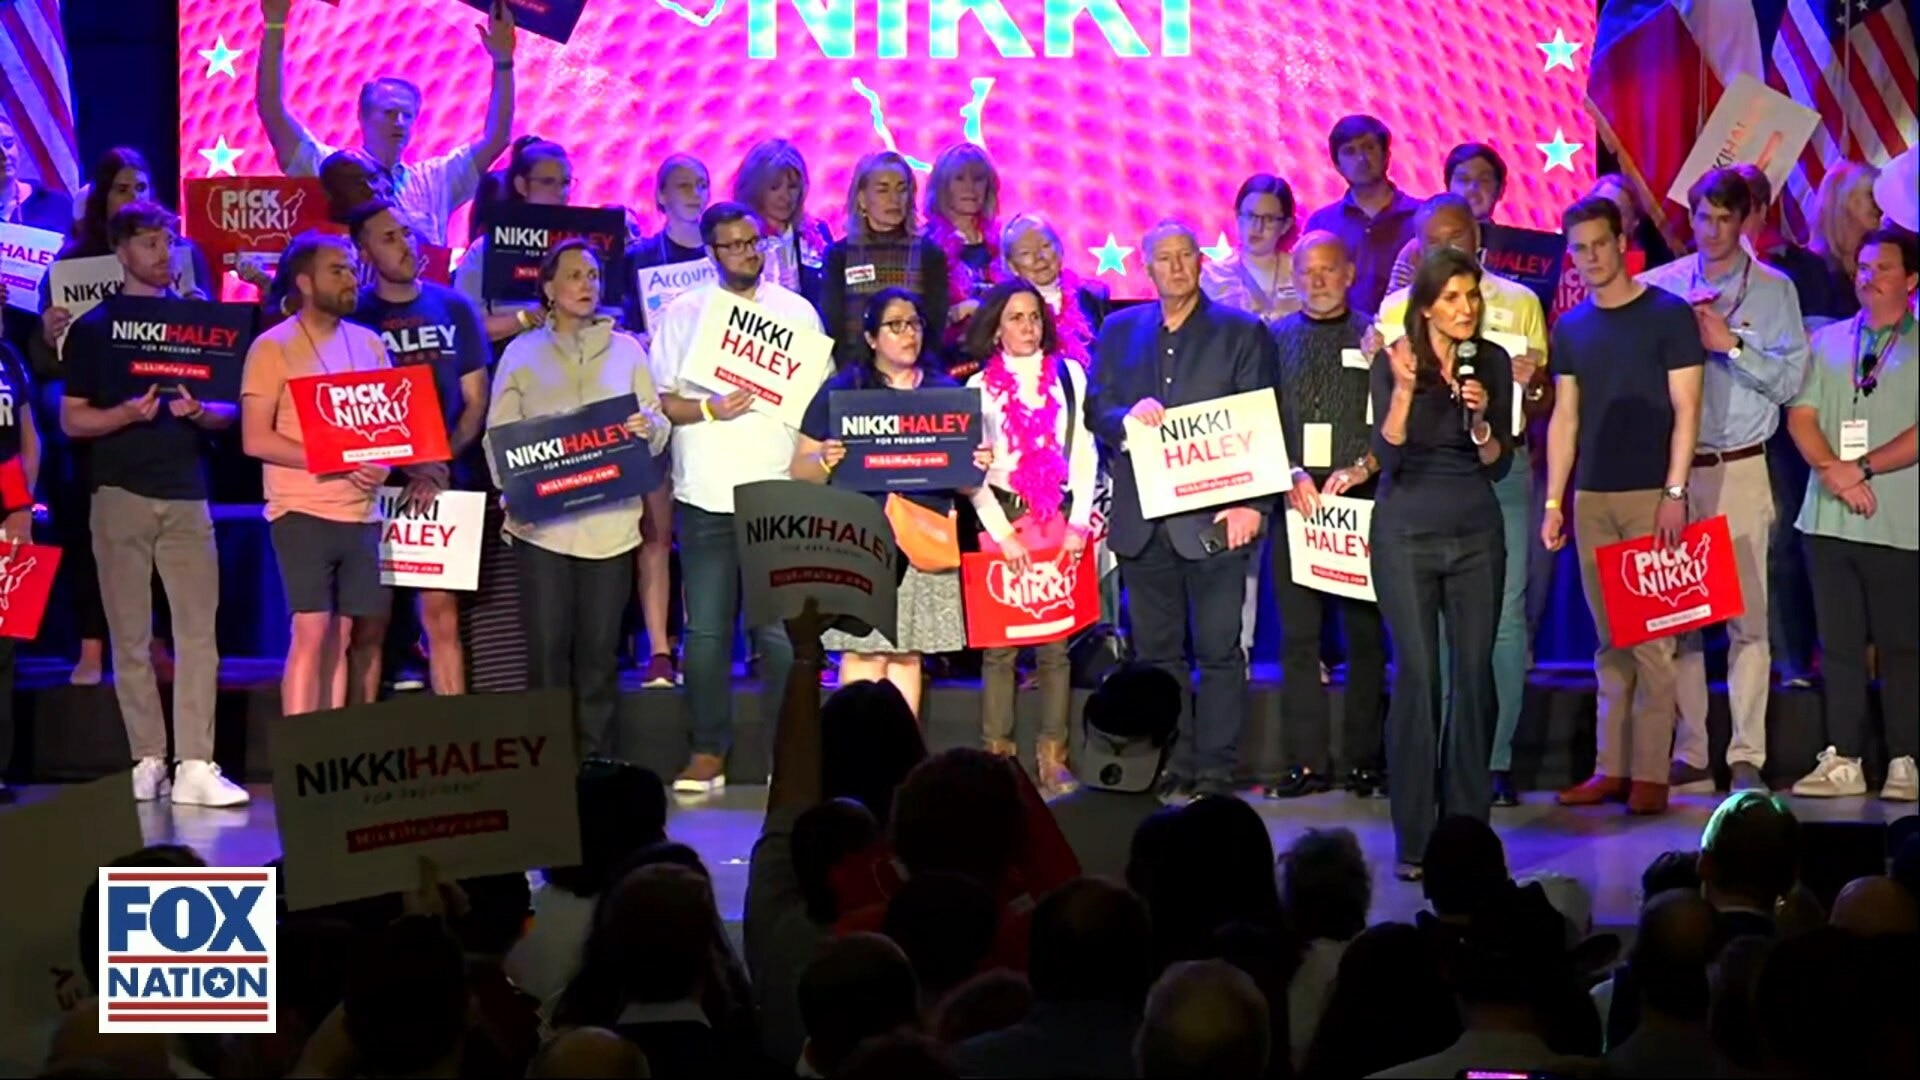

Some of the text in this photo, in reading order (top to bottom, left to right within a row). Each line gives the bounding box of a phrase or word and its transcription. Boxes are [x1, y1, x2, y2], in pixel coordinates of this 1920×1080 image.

[222, 189, 280, 208] PICK
[222, 208, 289, 230] NIKKI
[382, 324, 457, 353] ALEY
[728, 305, 794, 351] NIKKI
[721, 329, 802, 380] HALEY
[328, 382, 389, 406] PICK
[333, 400, 403, 427] NIKKI
[1160, 409, 1232, 443] NIKKI
[1163, 431, 1253, 469] HALEY
[383, 522, 457, 547] ALEY
[1304, 527, 1372, 558] HALEY
[1634, 541, 1691, 573] PICK
[1638, 559, 1701, 596] NIKKI
